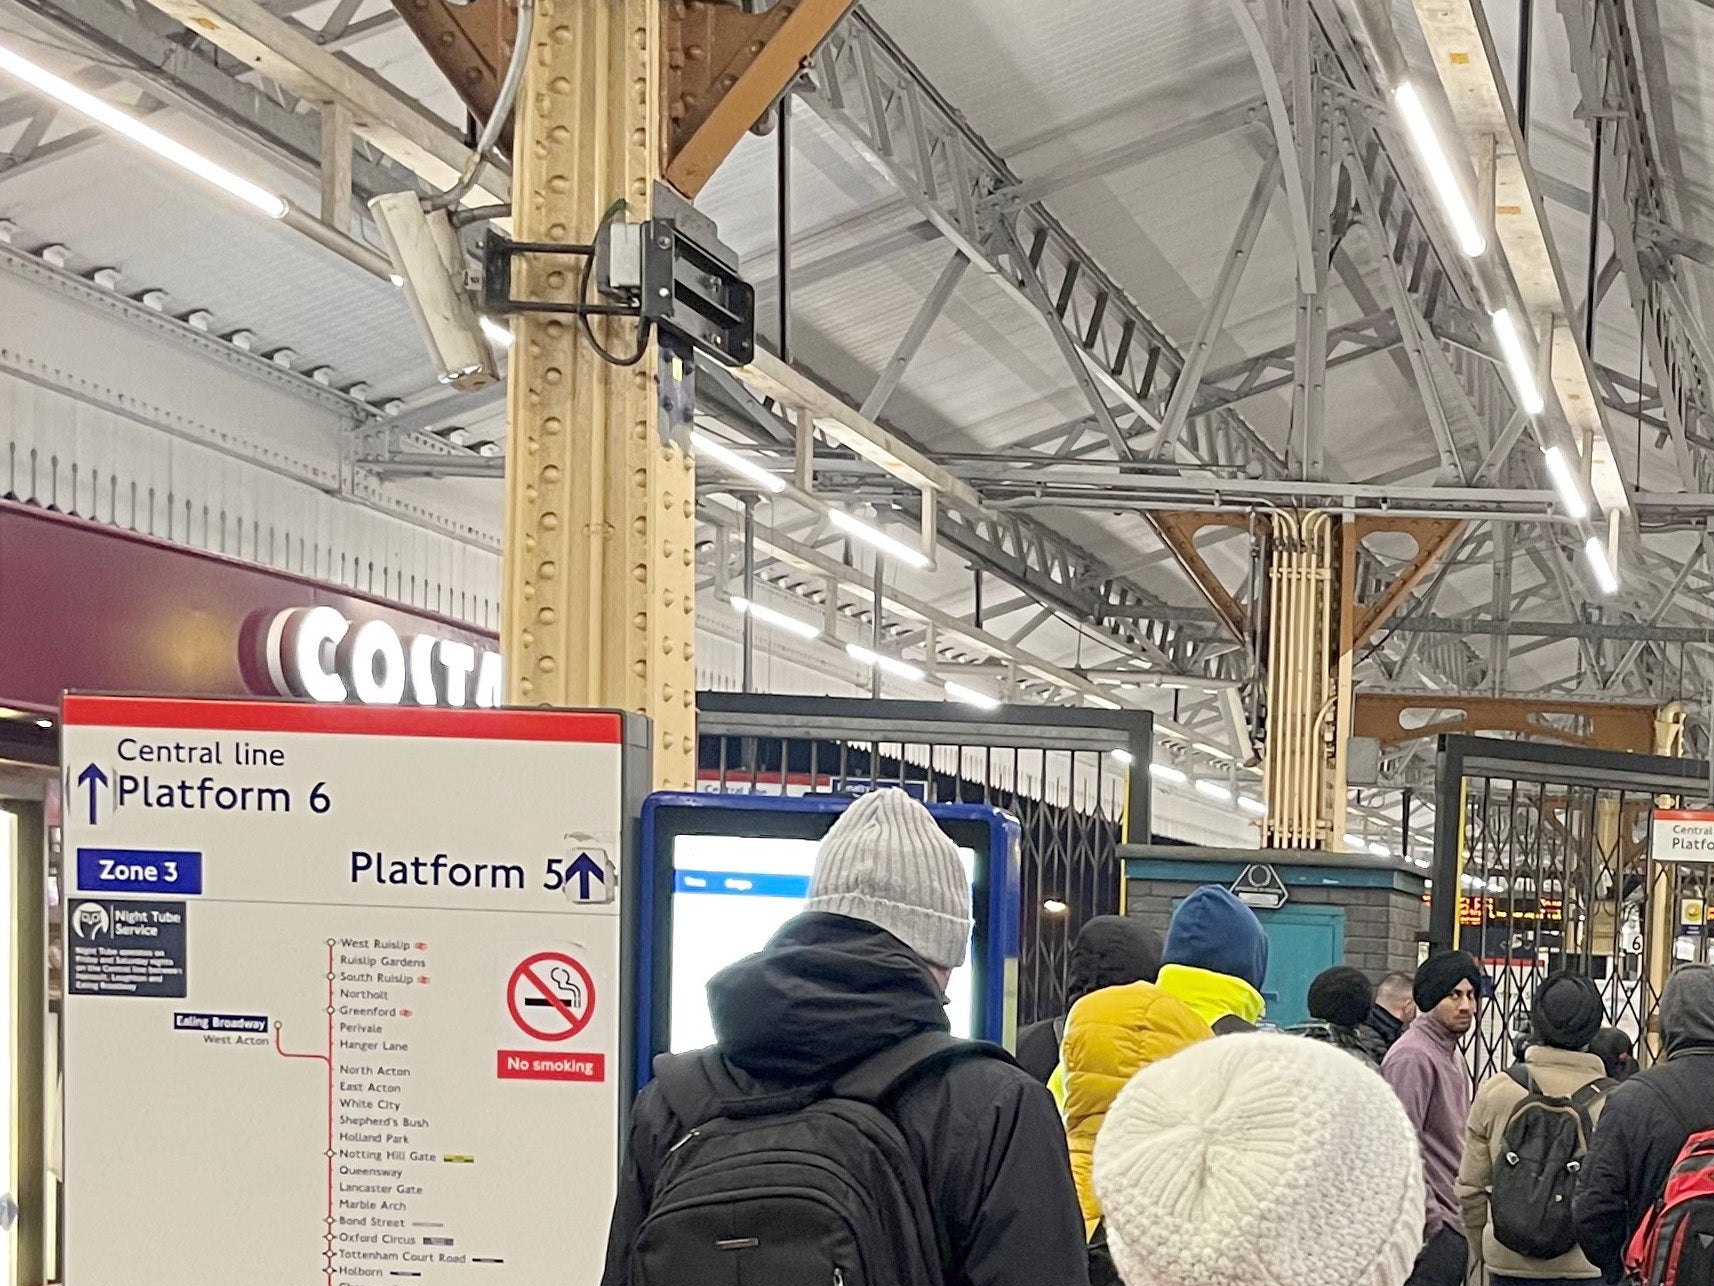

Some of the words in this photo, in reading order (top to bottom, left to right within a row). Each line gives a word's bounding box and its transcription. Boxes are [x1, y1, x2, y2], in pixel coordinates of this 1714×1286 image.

[117, 738, 222, 765] Central
[235, 742, 285, 767] line
[118, 775, 290, 812] Platform
[309, 781, 331, 813] 6
[1672, 824, 1713, 836] Central
[98, 860, 158, 882] Zone
[164, 861, 178, 882] 3
[351, 851, 524, 889] Platform
[543, 858, 563, 891] 5
[115, 910, 148, 924] Night
[152, 911, 181, 923] Tube
[115, 923, 158, 936] Service
[340, 939, 368, 948] West
[374, 940, 410, 950] Ruislip
[1632, 936, 1641, 951] 6
[340, 956, 376, 966] Ruislip
[381, 957, 425, 967] Gardens
[340, 972, 373, 982] South
[377, 973, 413, 984] Ruislip
[340, 1006, 396, 1017] Greenford
[176, 1016, 209, 1028] Ealing
[212, 1017, 265, 1031] Broadway
[340, 1023, 382, 1033] Perivale
[204, 1035, 231, 1044] West
[236, 1036, 269, 1046] Acton
[340, 1040, 378, 1053] Hanger
[383, 1042, 408, 1051] Lane
[340, 1066, 373, 1075] North
[377, 1066, 410, 1076] Acton
[507, 1056, 529, 1070] No
[533, 1058, 594, 1076] smoking
[340, 1082, 362, 1092] East
[368, 1083, 400, 1093] Acton
[340, 1099, 373, 1108] White
[378, 1100, 400, 1111] City
[340, 1116, 398, 1128] Shepherd's
[403, 1118, 429, 1128] Bush
[340, 1133, 381, 1143] Holland
[386, 1134, 408, 1144] Park
[339, 1150, 382, 1162] Notting
[387, 1151, 405, 1160] Hill
[410, 1153, 436, 1162] Gate
[339, 1166, 402, 1178] Queensway
[339, 1183, 392, 1193] Lancaster
[397, 1185, 423, 1195] Gate
[339, 1200, 376, 1210] Marble
[381, 1201, 406, 1211] Arch
[339, 1216, 366, 1226] Bond
[371, 1217, 404, 1227] Street
[339, 1233, 377, 1243] Oxford
[383, 1234, 415, 1244] Circus
[339, 1250, 398, 1261] Tottenham
[403, 1252, 434, 1262] Court
[439, 1253, 466, 1263] Road
[339, 1266, 383, 1276] Holborn
